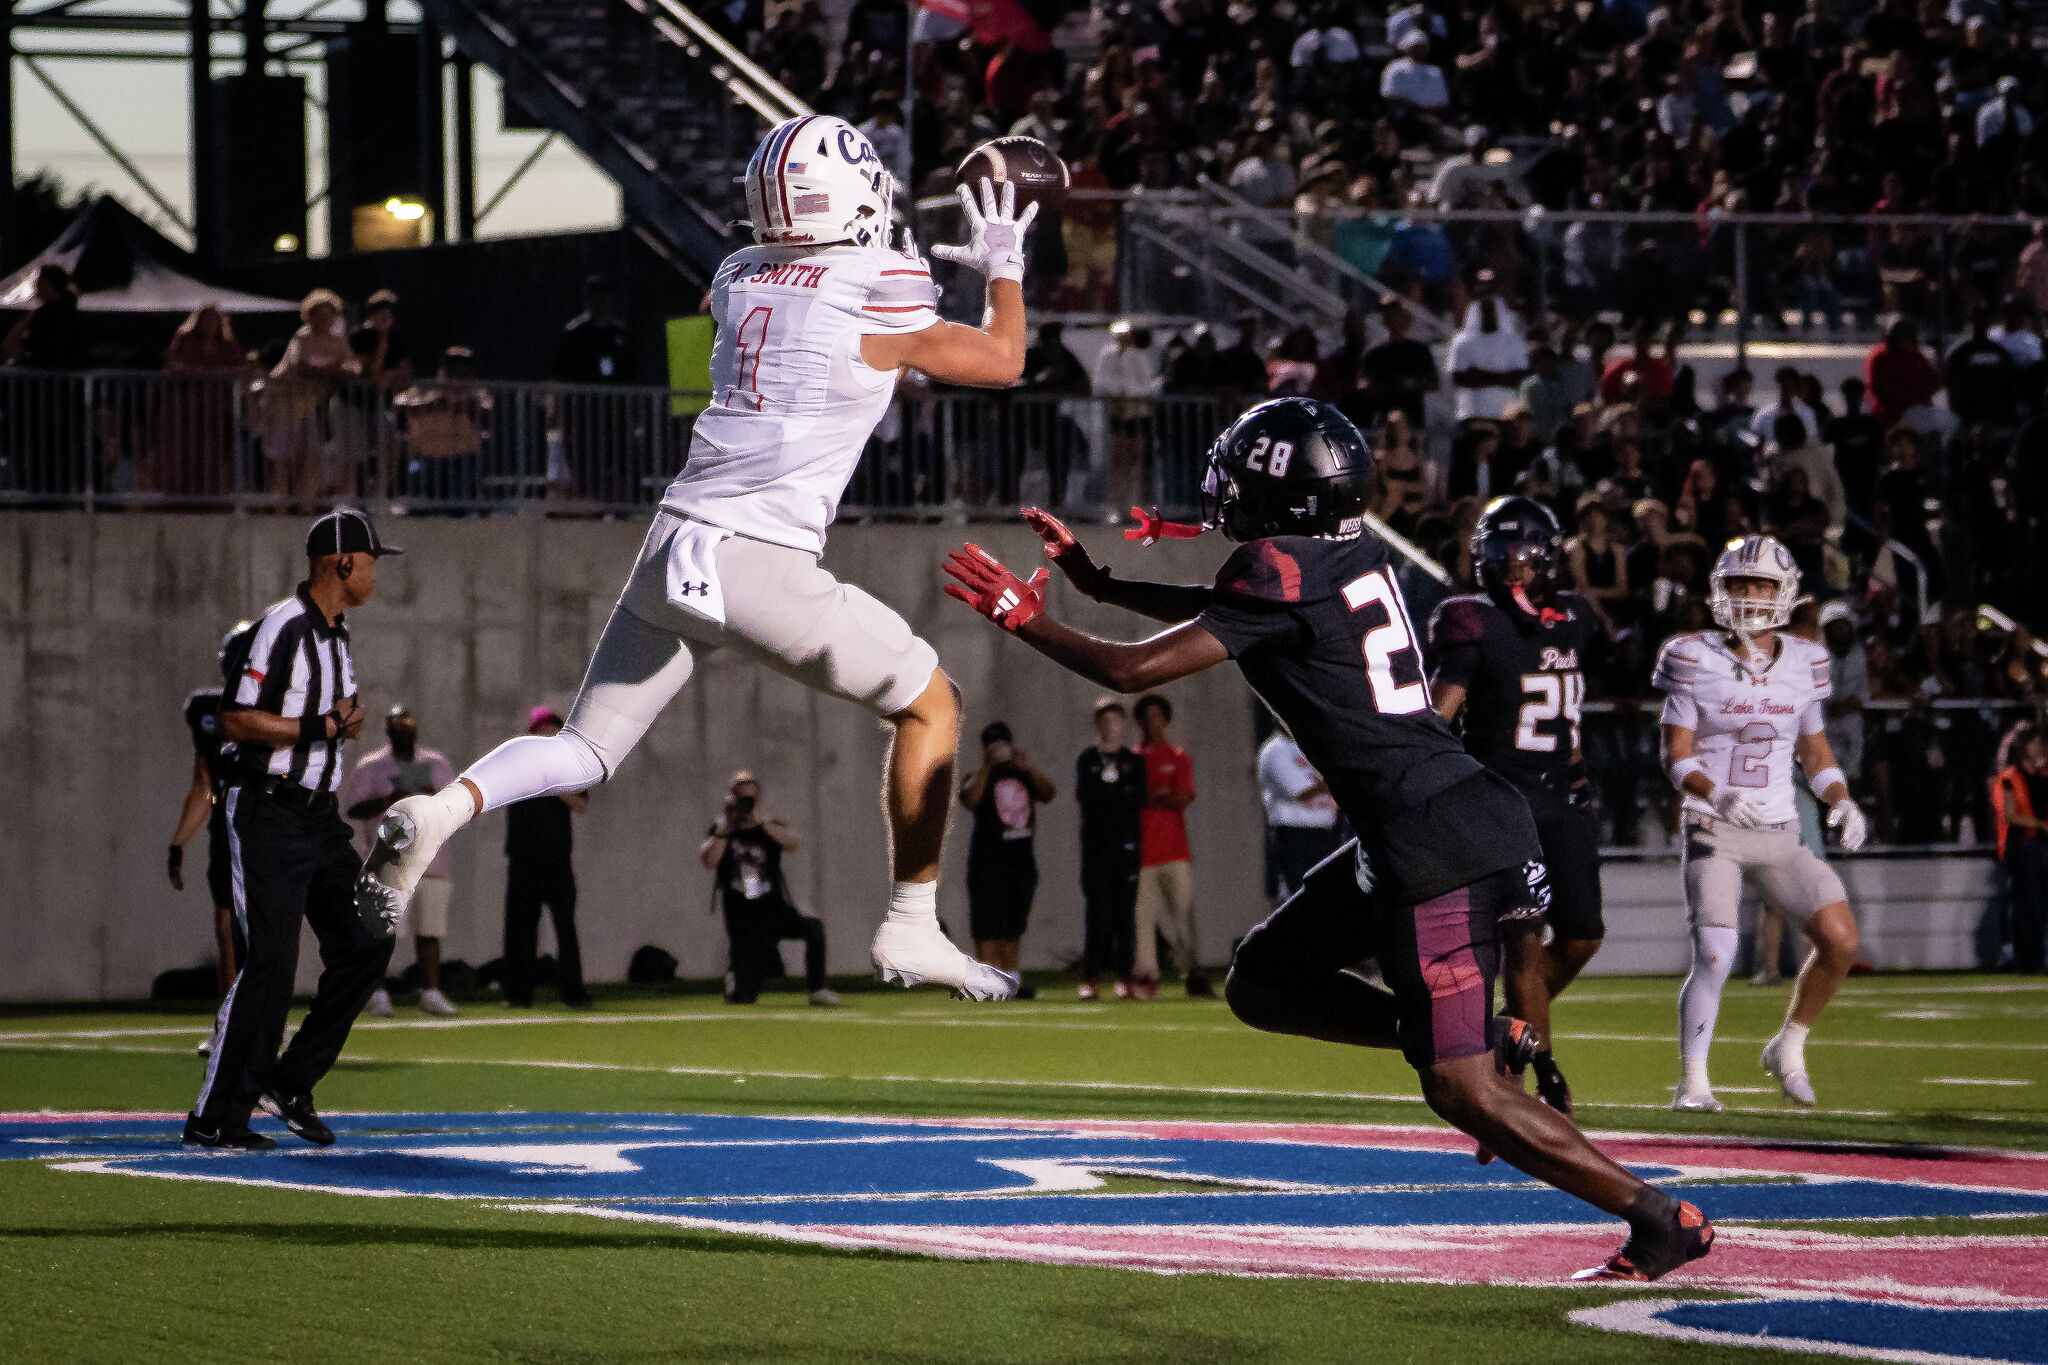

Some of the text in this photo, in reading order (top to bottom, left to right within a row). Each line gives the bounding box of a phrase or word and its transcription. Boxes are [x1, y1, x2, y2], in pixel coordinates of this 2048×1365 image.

[750, 262, 829, 288] SMITH
[725, 306, 773, 412] 1
[1246, 436, 1294, 478] 28
[1340, 564, 1432, 715] 2
[1515, 672, 1585, 752] 24
[1728, 721, 1779, 788] 2
